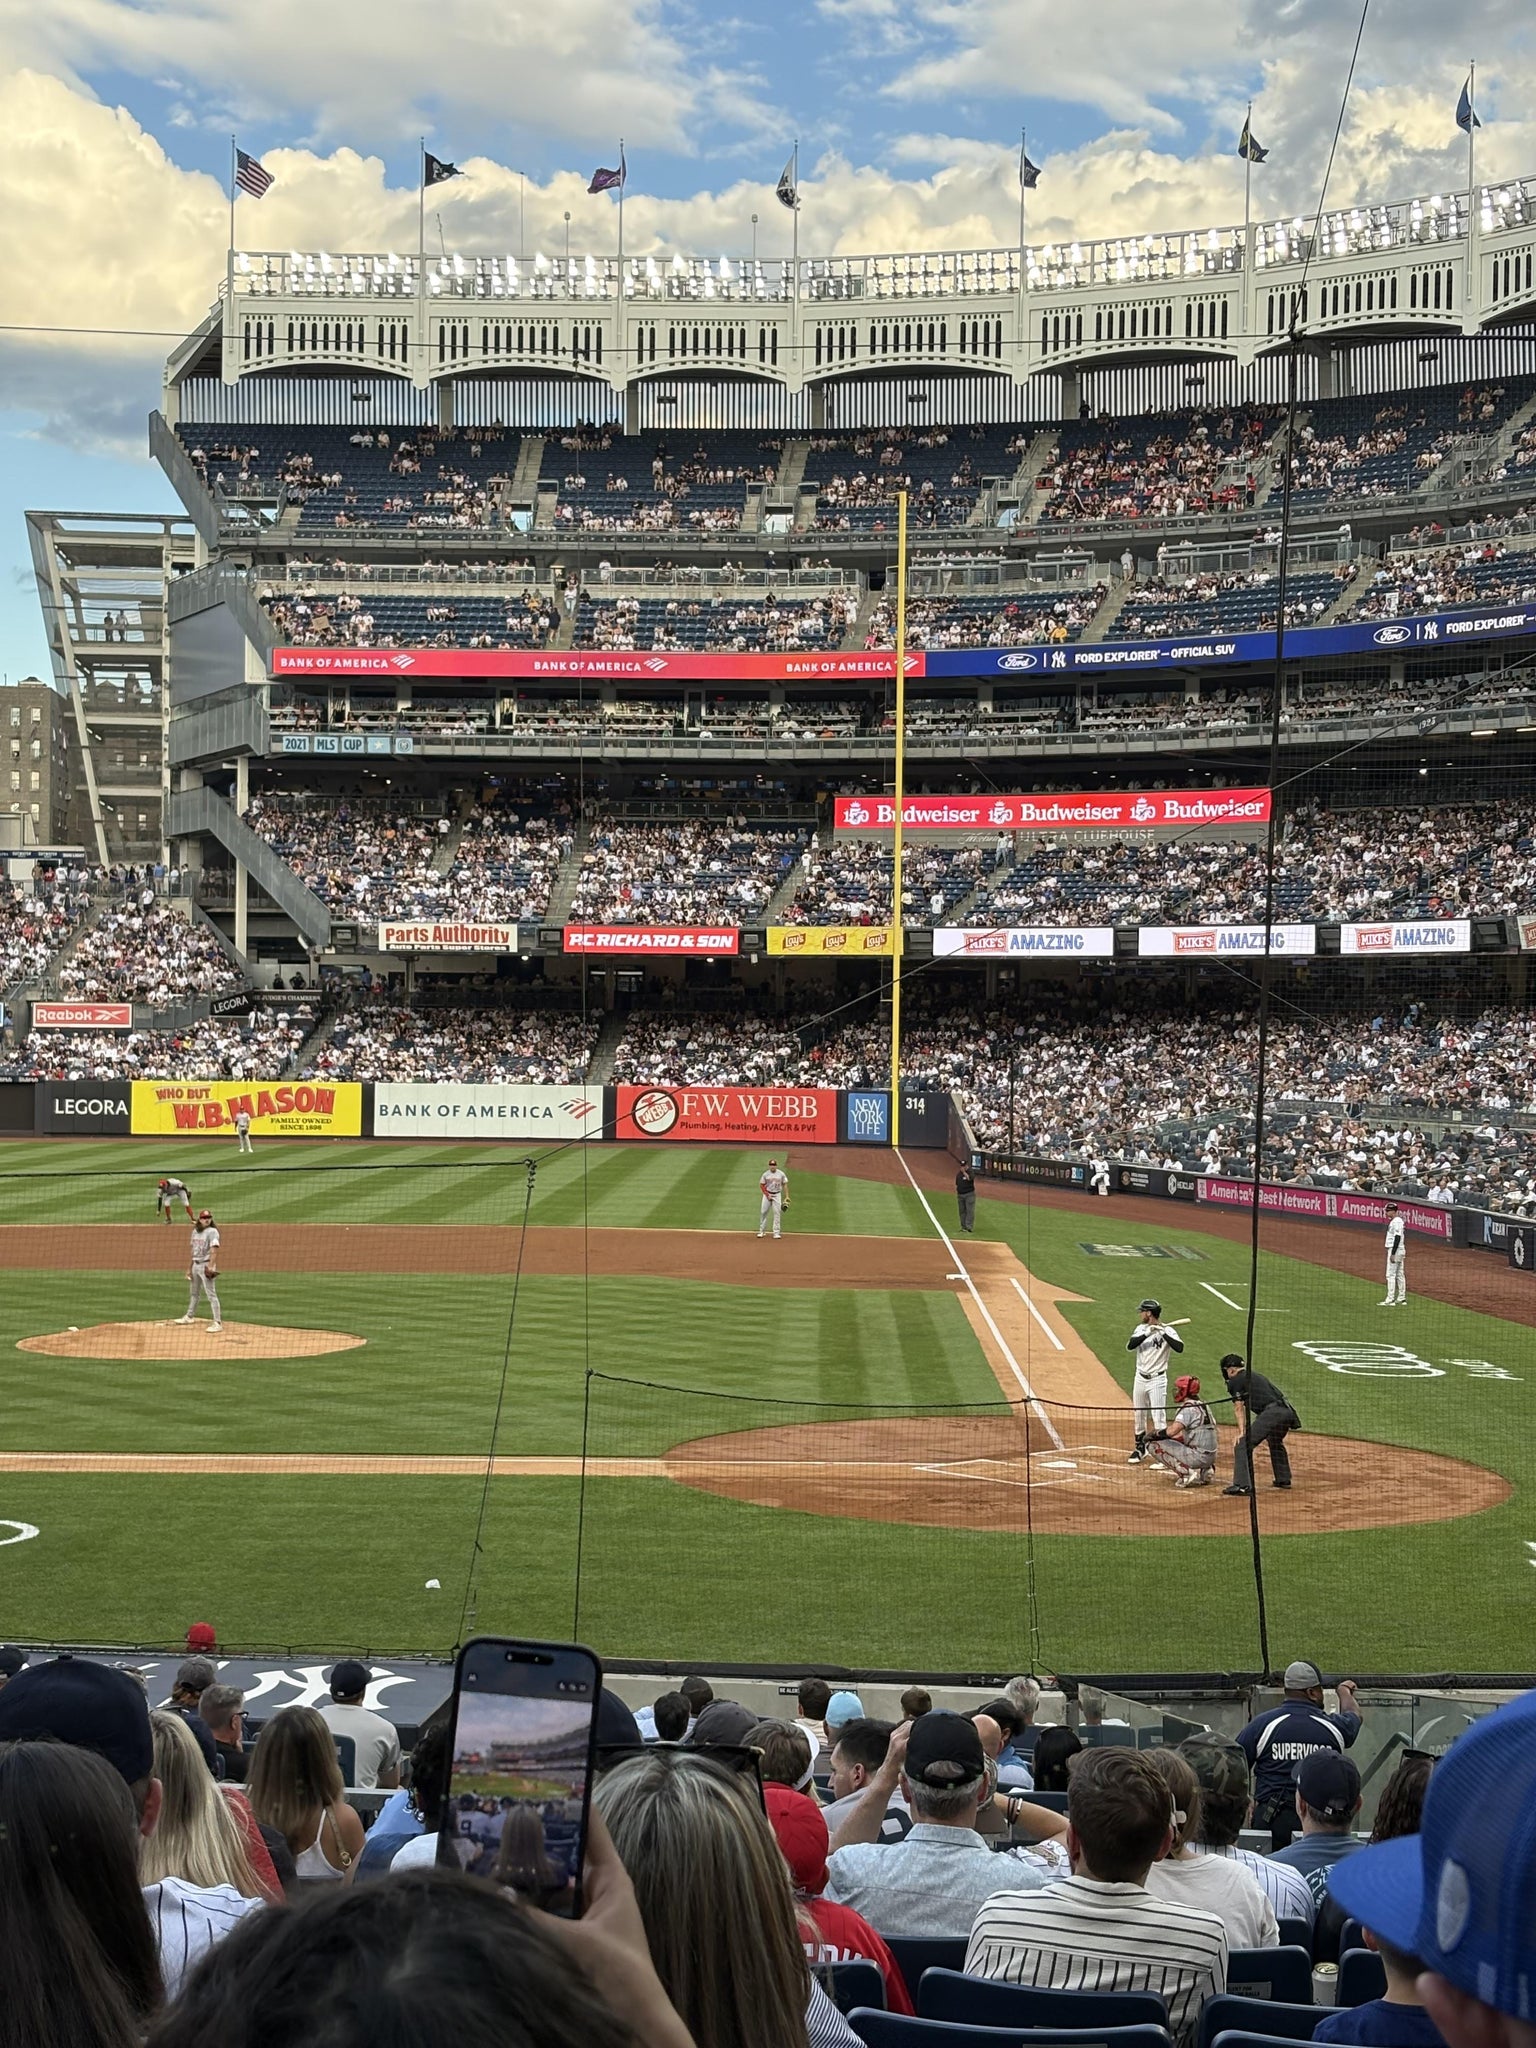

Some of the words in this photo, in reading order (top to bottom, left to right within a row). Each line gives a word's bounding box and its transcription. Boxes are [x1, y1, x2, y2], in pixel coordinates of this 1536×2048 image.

[1446, 622, 1473, 634] FORD
[1074, 652, 1103, 664] FORD
[1170, 645, 1214, 659] OFFICIAL
[1214, 643, 1236, 655] SUV
[280, 657, 314, 668] BANK
[316, 658, 332, 668] OF
[334, 658, 389, 669] AMERICA
[533, 661, 567, 671] BANK
[569, 661, 585, 671] OF
[587, 661, 642, 672] AMERICA
[786, 662, 818, 673] BANK
[820, 662, 837, 672] OF
[838, 661, 892, 672] AMERICA
[285, 738, 307, 750] 2021
[316, 738, 336, 751] MLS
[343, 738, 363, 751] CUP
[1020, 803, 1122, 822] Budweiser
[1163, 799, 1265, 819] Budweiser
[1019, 830, 1068, 842] ULTRA
[385, 927, 429, 942] Parts
[433, 924, 510, 944] Authority
[596, 933, 680, 947] RICHARD
[680, 934, 695, 947] &
[696, 935, 733, 948] SON
[1178, 935, 1214, 949] MIKE'S
[1218, 932, 1285, 949] AMAZING
[1360, 931, 1391, 945] MIKE'S
[1394, 927, 1456, 946] AMAZING
[968, 936, 1005, 949] MIKE'S
[1009, 934, 1085, 950] AMAZING
[213, 994, 249, 1014] LEGORA
[36, 1008, 93, 1022] Reebok
[156, 1088, 184, 1100] WHO
[187, 1087, 211, 1099] BUT
[54, 1098, 129, 1116] LEGORA
[172, 1101, 232, 1129] W.B.
[226, 1086, 336, 1123] MASON
[737, 1094, 818, 1118] WEBB
[855, 1098, 882, 1112] NEW
[905, 1097, 925, 1110] 314
[379, 1104, 431, 1117] BANK
[437, 1105, 461, 1117] OF
[466, 1105, 554, 1119] AMERICA
[642, 1102, 669, 1123] WEBB
[850, 1109, 885, 1124] YORK
[270, 1117, 301, 1125] FAMILY
[680, 1121, 723, 1131] Plumbing,
[724, 1122, 760, 1132] Heating,
[793, 1124, 799, 1132] &
[855, 1121, 881, 1135] LIFE
[1210, 1183, 1255, 1202] America's
[1258, 1188, 1278, 1205] Best
[1279, 1191, 1321, 1211] Network
[1411, 1208, 1443, 1231] Network
[1271, 1742, 1333, 1761] SUPERVI
